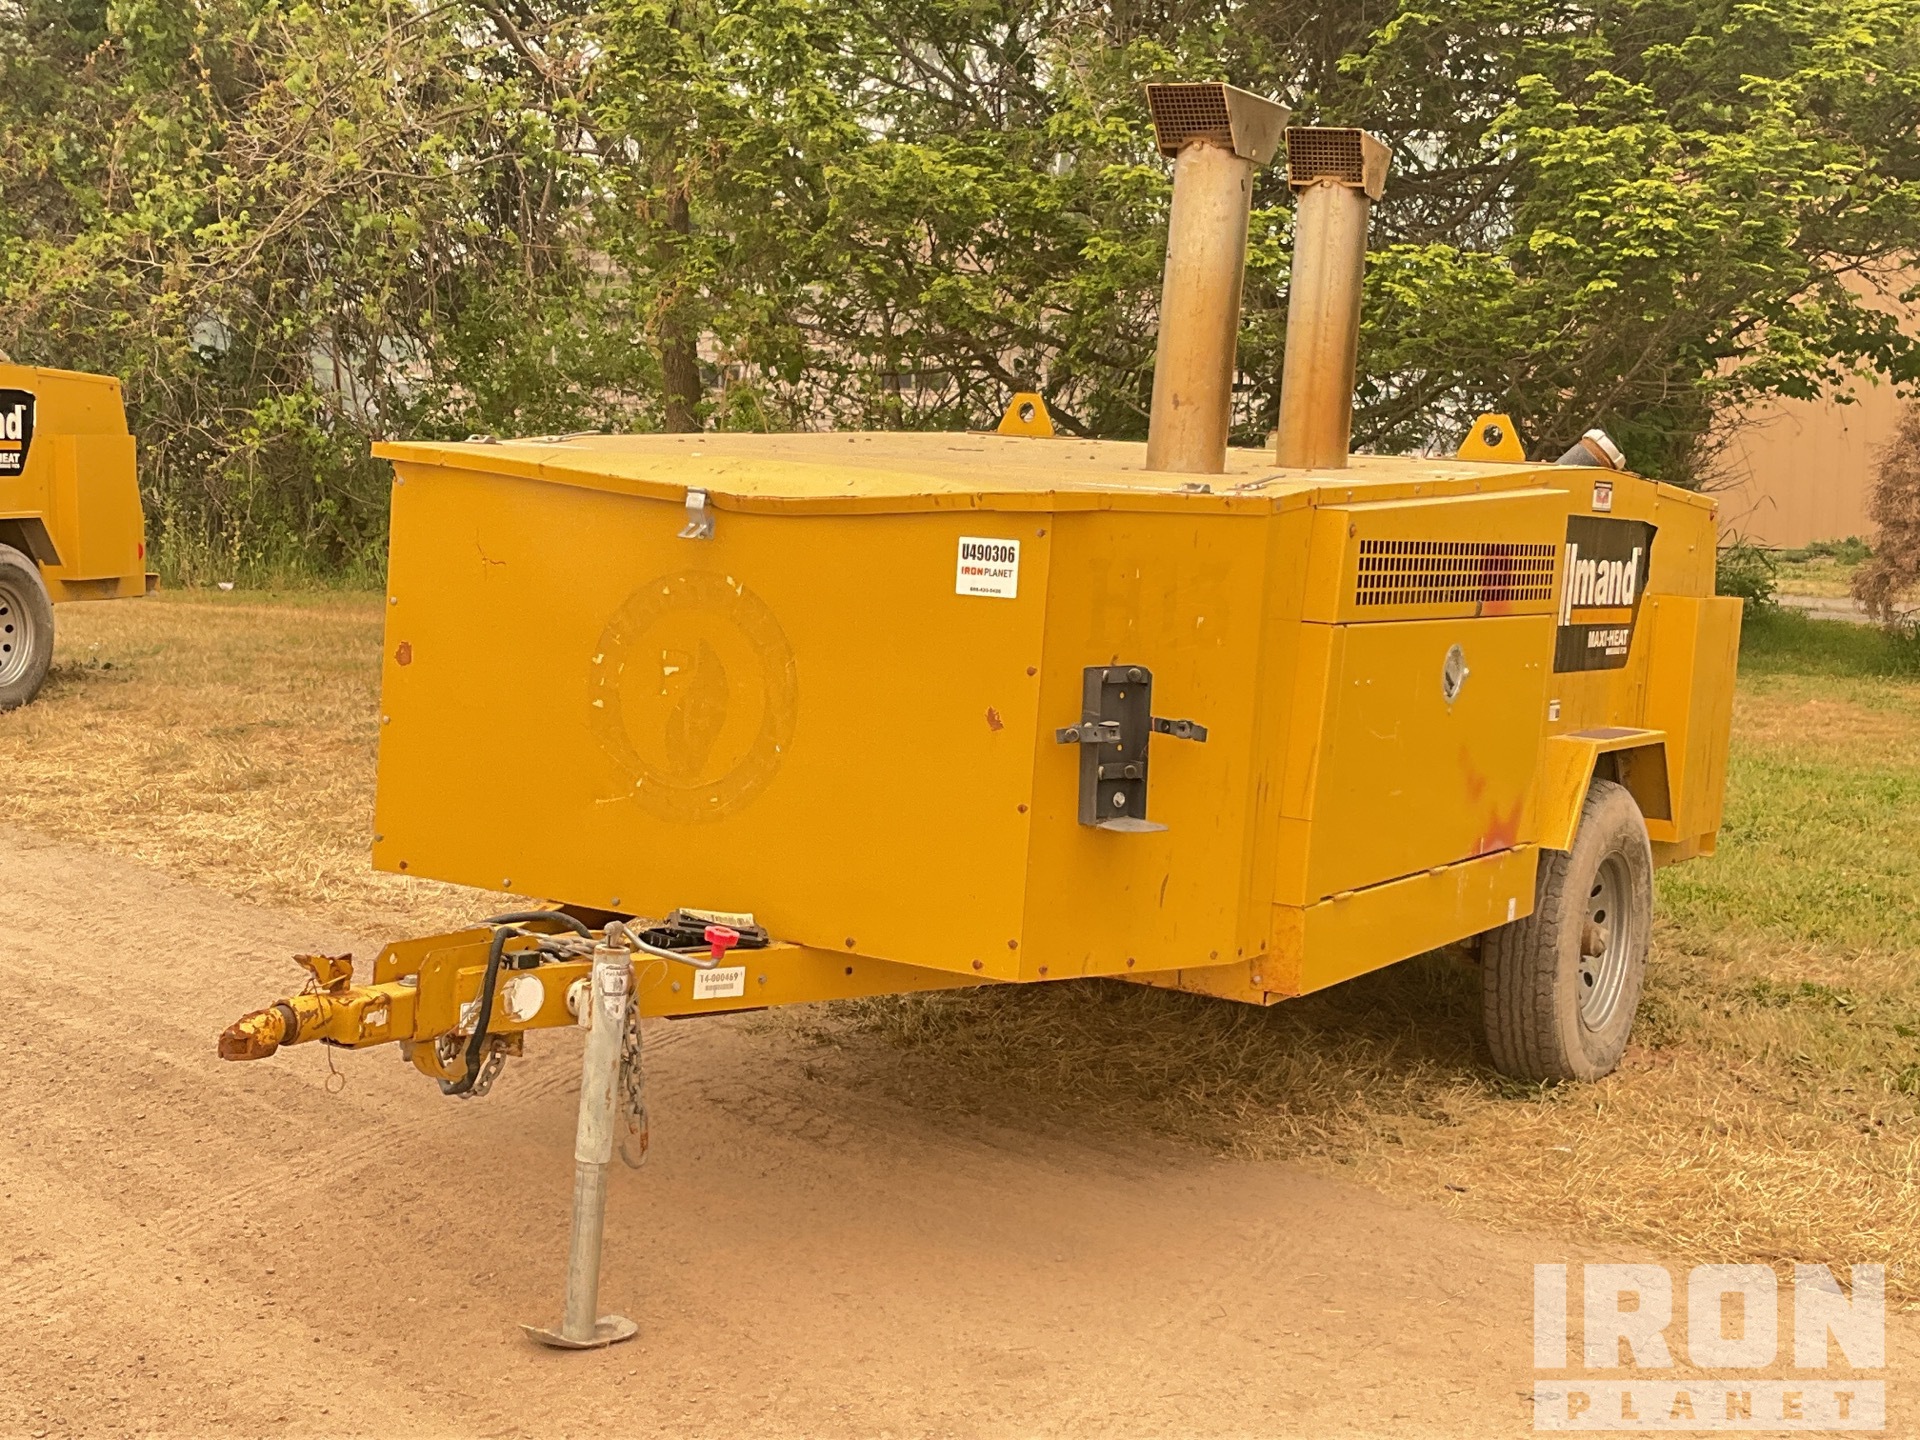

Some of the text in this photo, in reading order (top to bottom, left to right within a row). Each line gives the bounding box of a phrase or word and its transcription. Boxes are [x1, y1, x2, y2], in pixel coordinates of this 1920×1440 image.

[962, 543, 1015, 563] U490306
[1558, 543, 1638, 626] llmand
[1588, 629, 1629, 648] MAXI-HEAT
